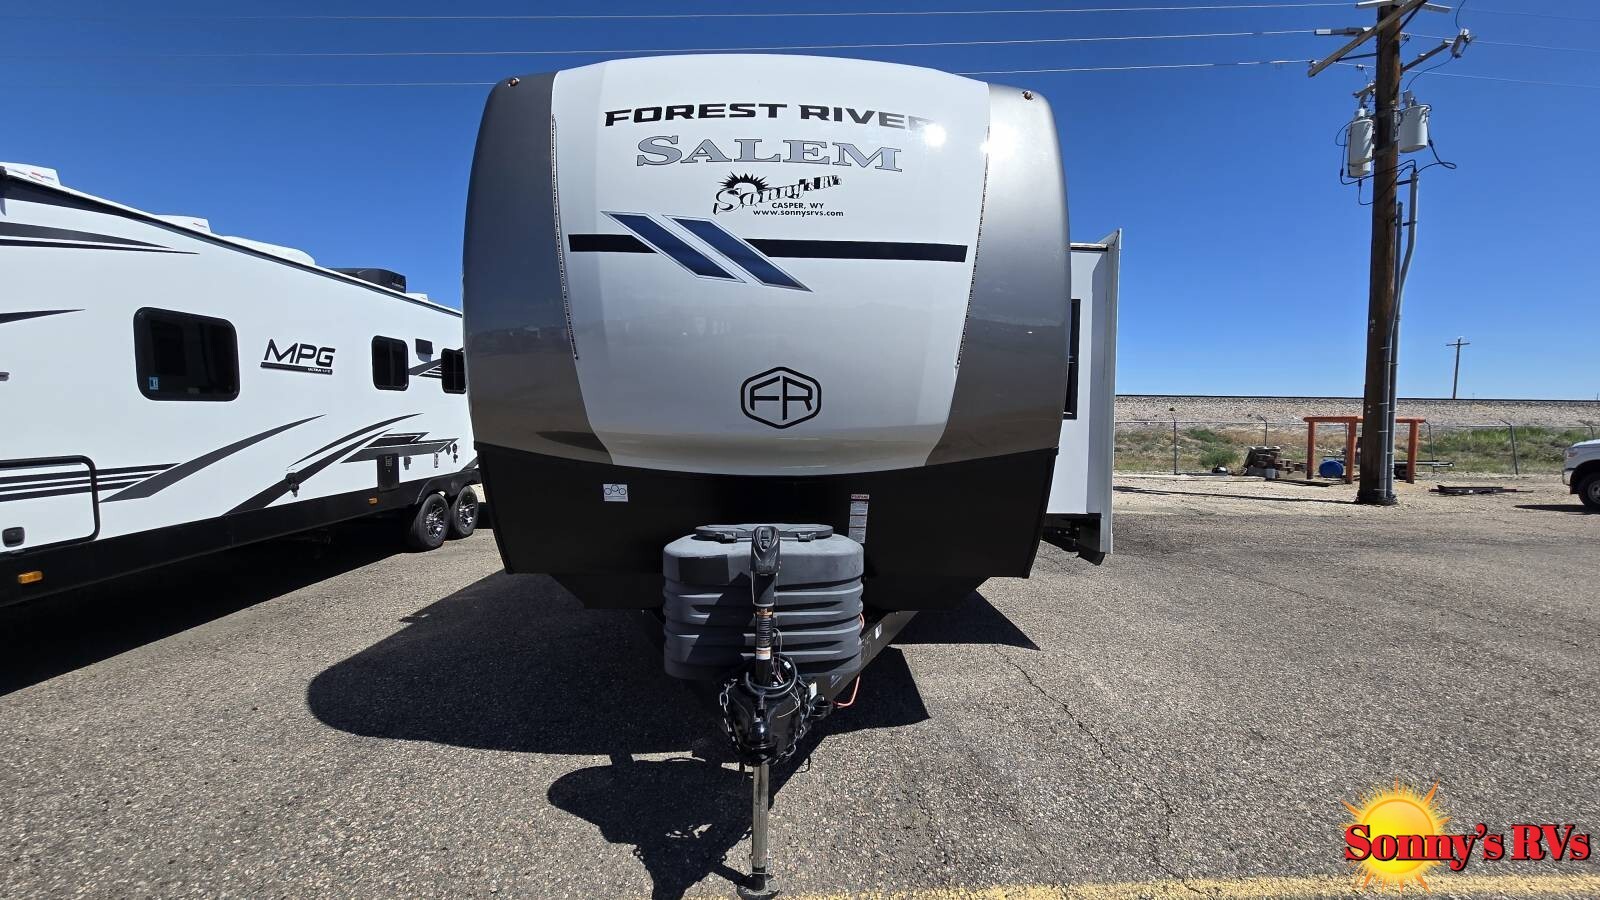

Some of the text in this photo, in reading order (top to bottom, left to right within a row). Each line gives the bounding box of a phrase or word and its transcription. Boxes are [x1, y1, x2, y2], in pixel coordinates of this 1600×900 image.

[604, 103, 787, 127] FOREST
[636, 135, 902, 172] SALEM
[752, 209, 844, 217] www.sonnysrvs.com
[771, 202, 806, 210] CASPER,
[263, 338, 336, 367] MPG
[749, 375, 813, 421] FR
